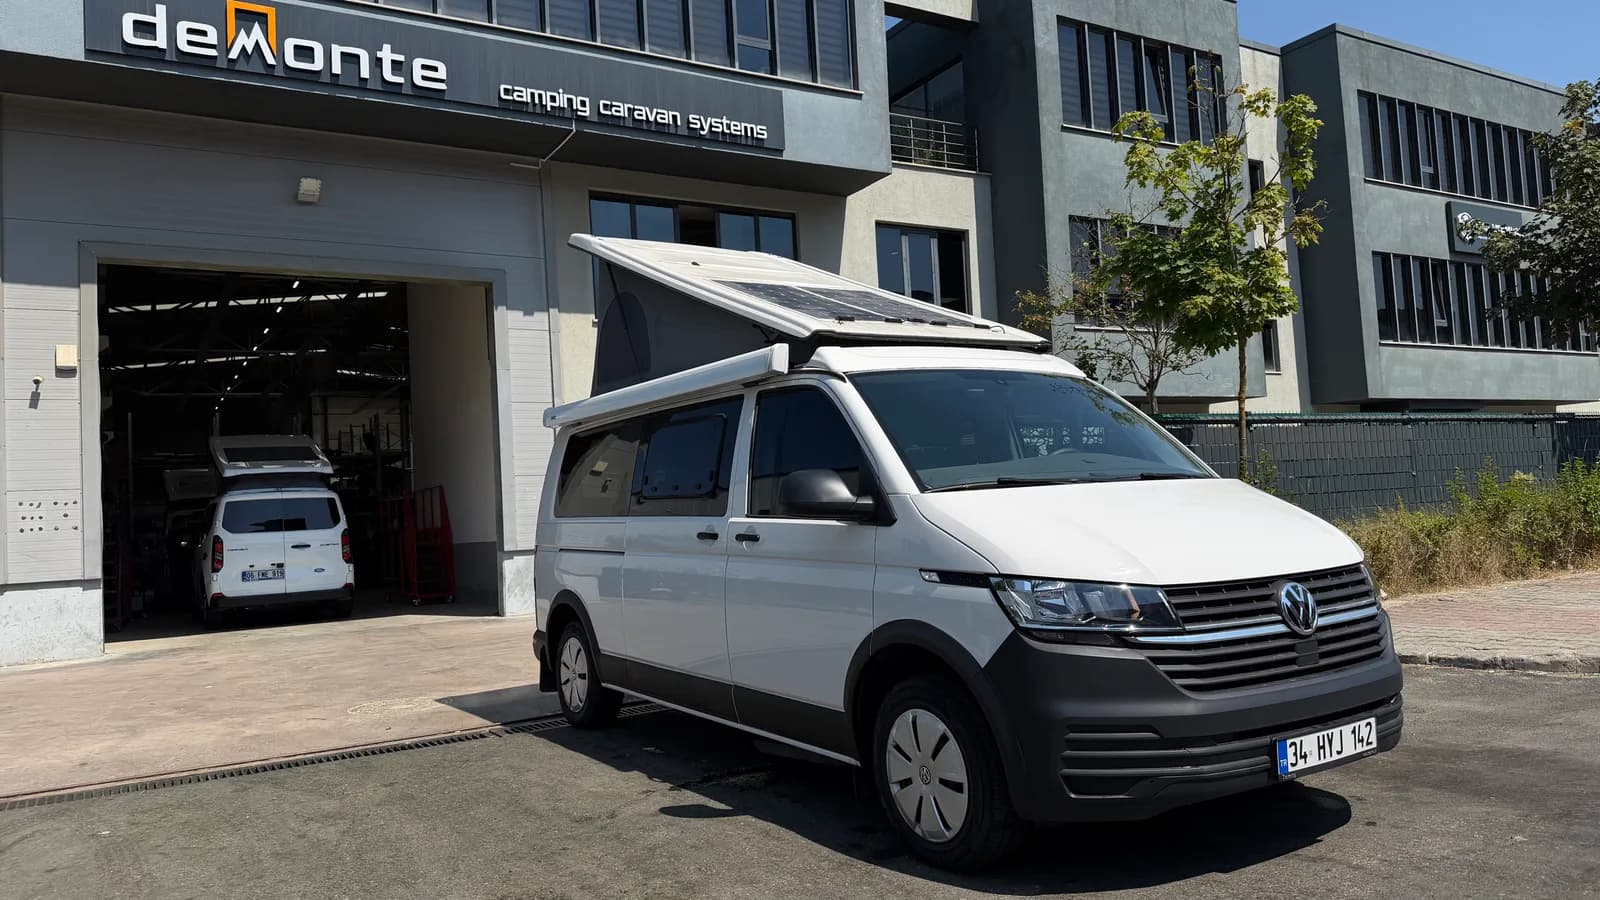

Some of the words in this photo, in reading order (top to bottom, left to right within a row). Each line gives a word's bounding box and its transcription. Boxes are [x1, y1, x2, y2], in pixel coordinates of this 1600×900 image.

[499, 83, 590, 116] camping
[599, 99, 681, 126] caravan
[688, 113, 768, 139] systems
[1289, 739, 1308, 767] 34
[1317, 729, 1344, 760] HYJ
[1351, 721, 1373, 751] 142
